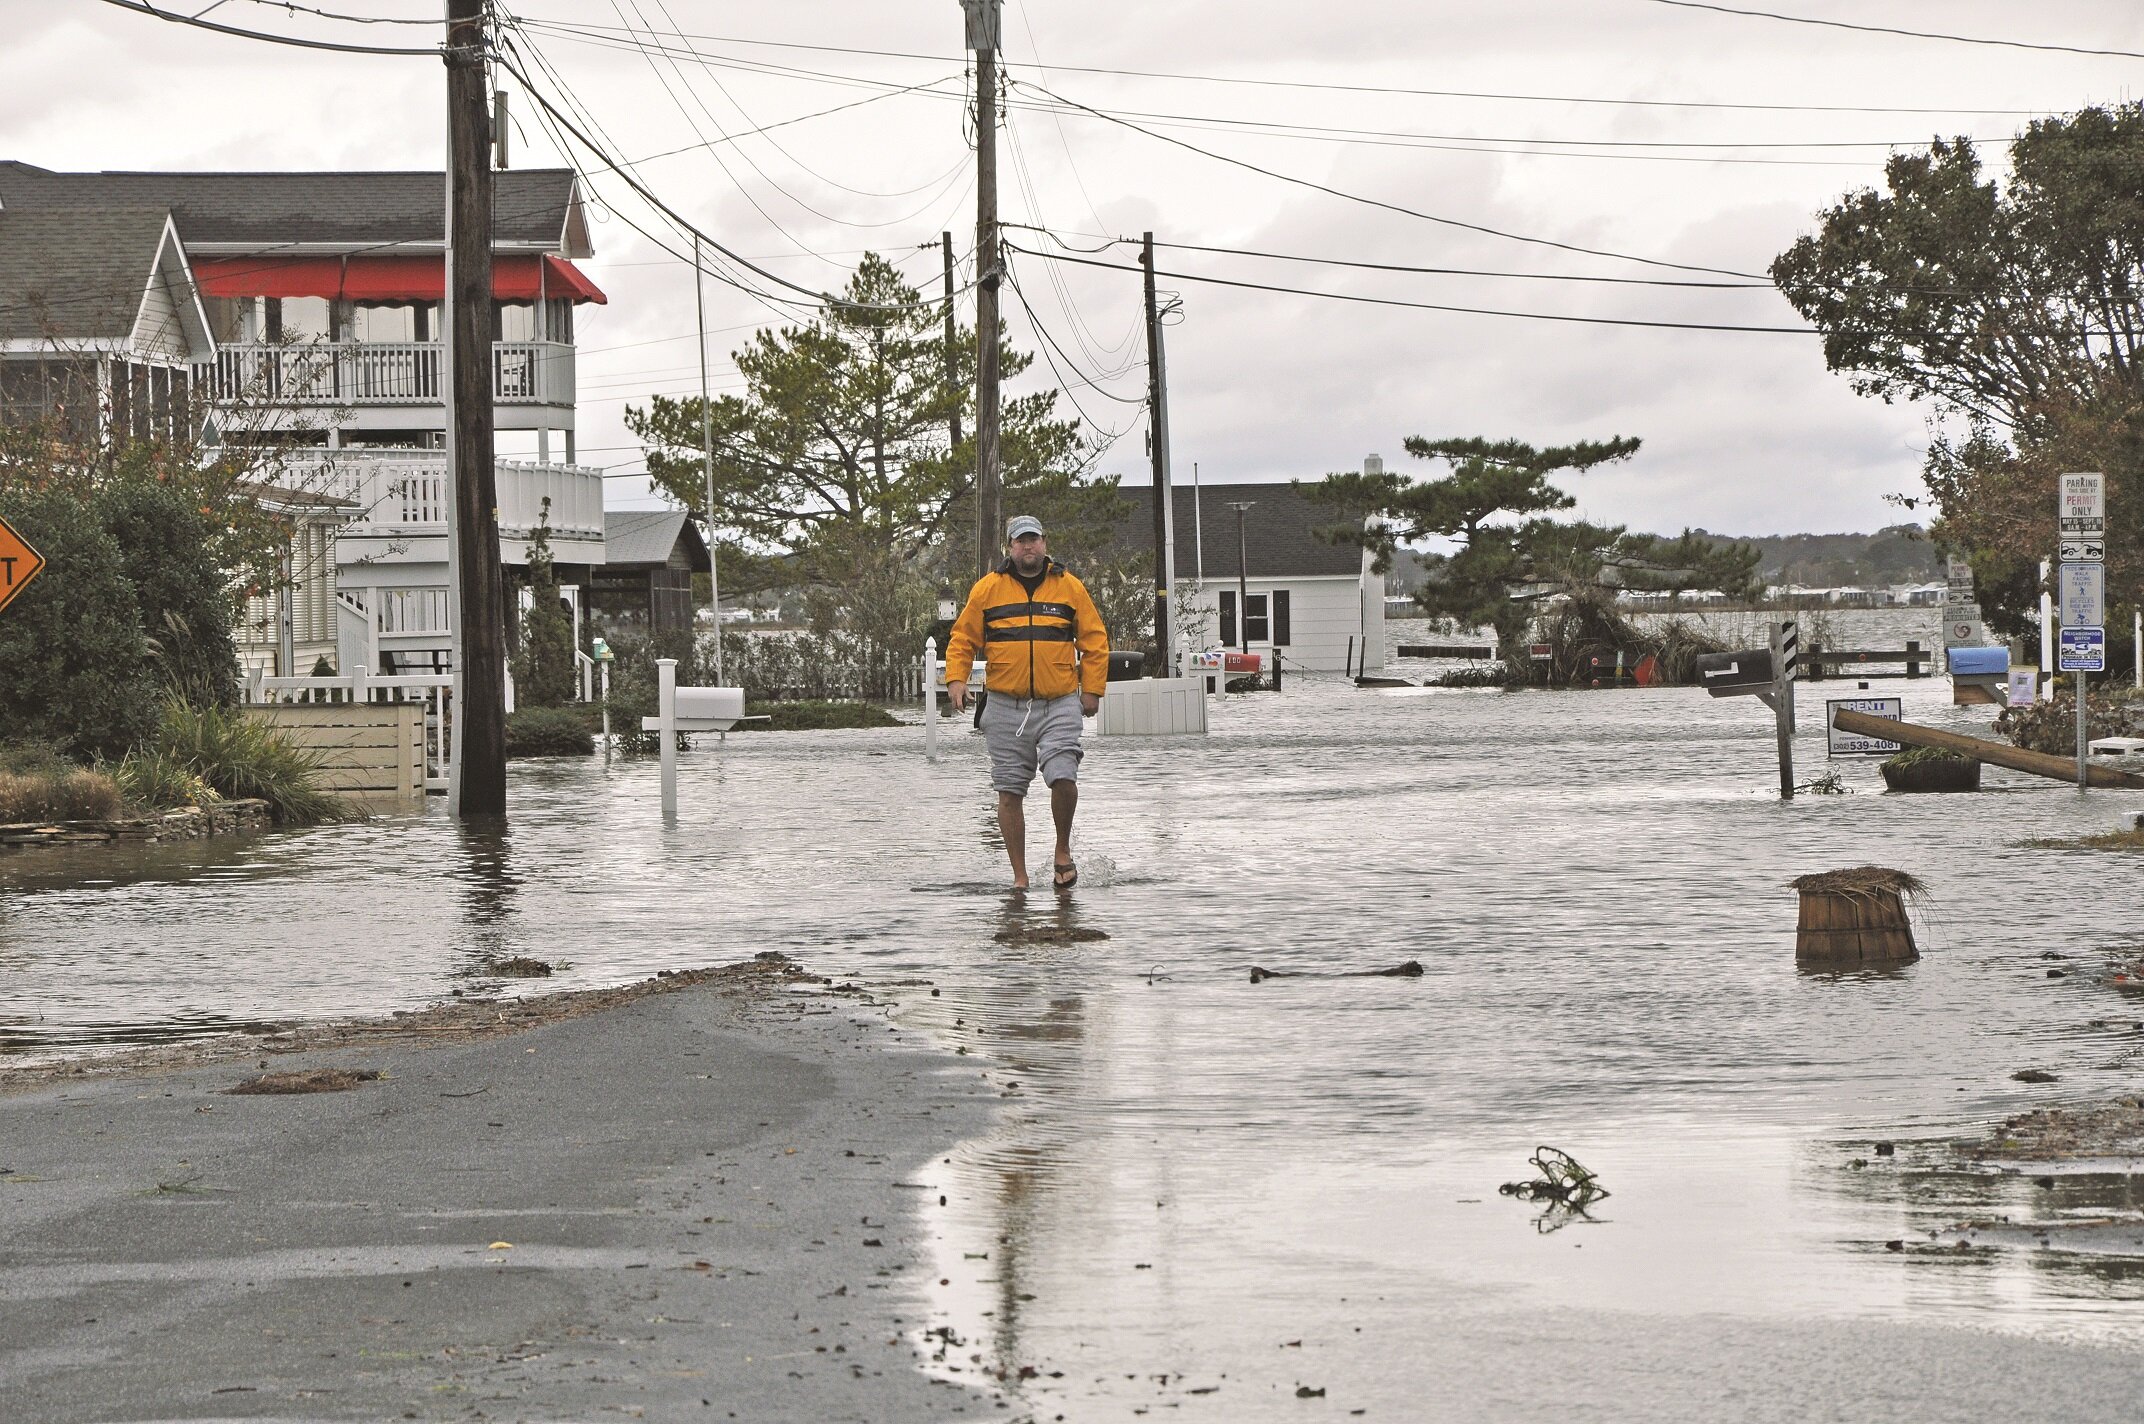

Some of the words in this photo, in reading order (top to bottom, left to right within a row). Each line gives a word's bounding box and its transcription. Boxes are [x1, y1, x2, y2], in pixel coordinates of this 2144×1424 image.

[2066, 479, 2098, 488] PARKING
[2066, 496, 2097, 505] PERMIT
[2071, 507, 2092, 516] ONLY
[0, 557, 17, 585] T
